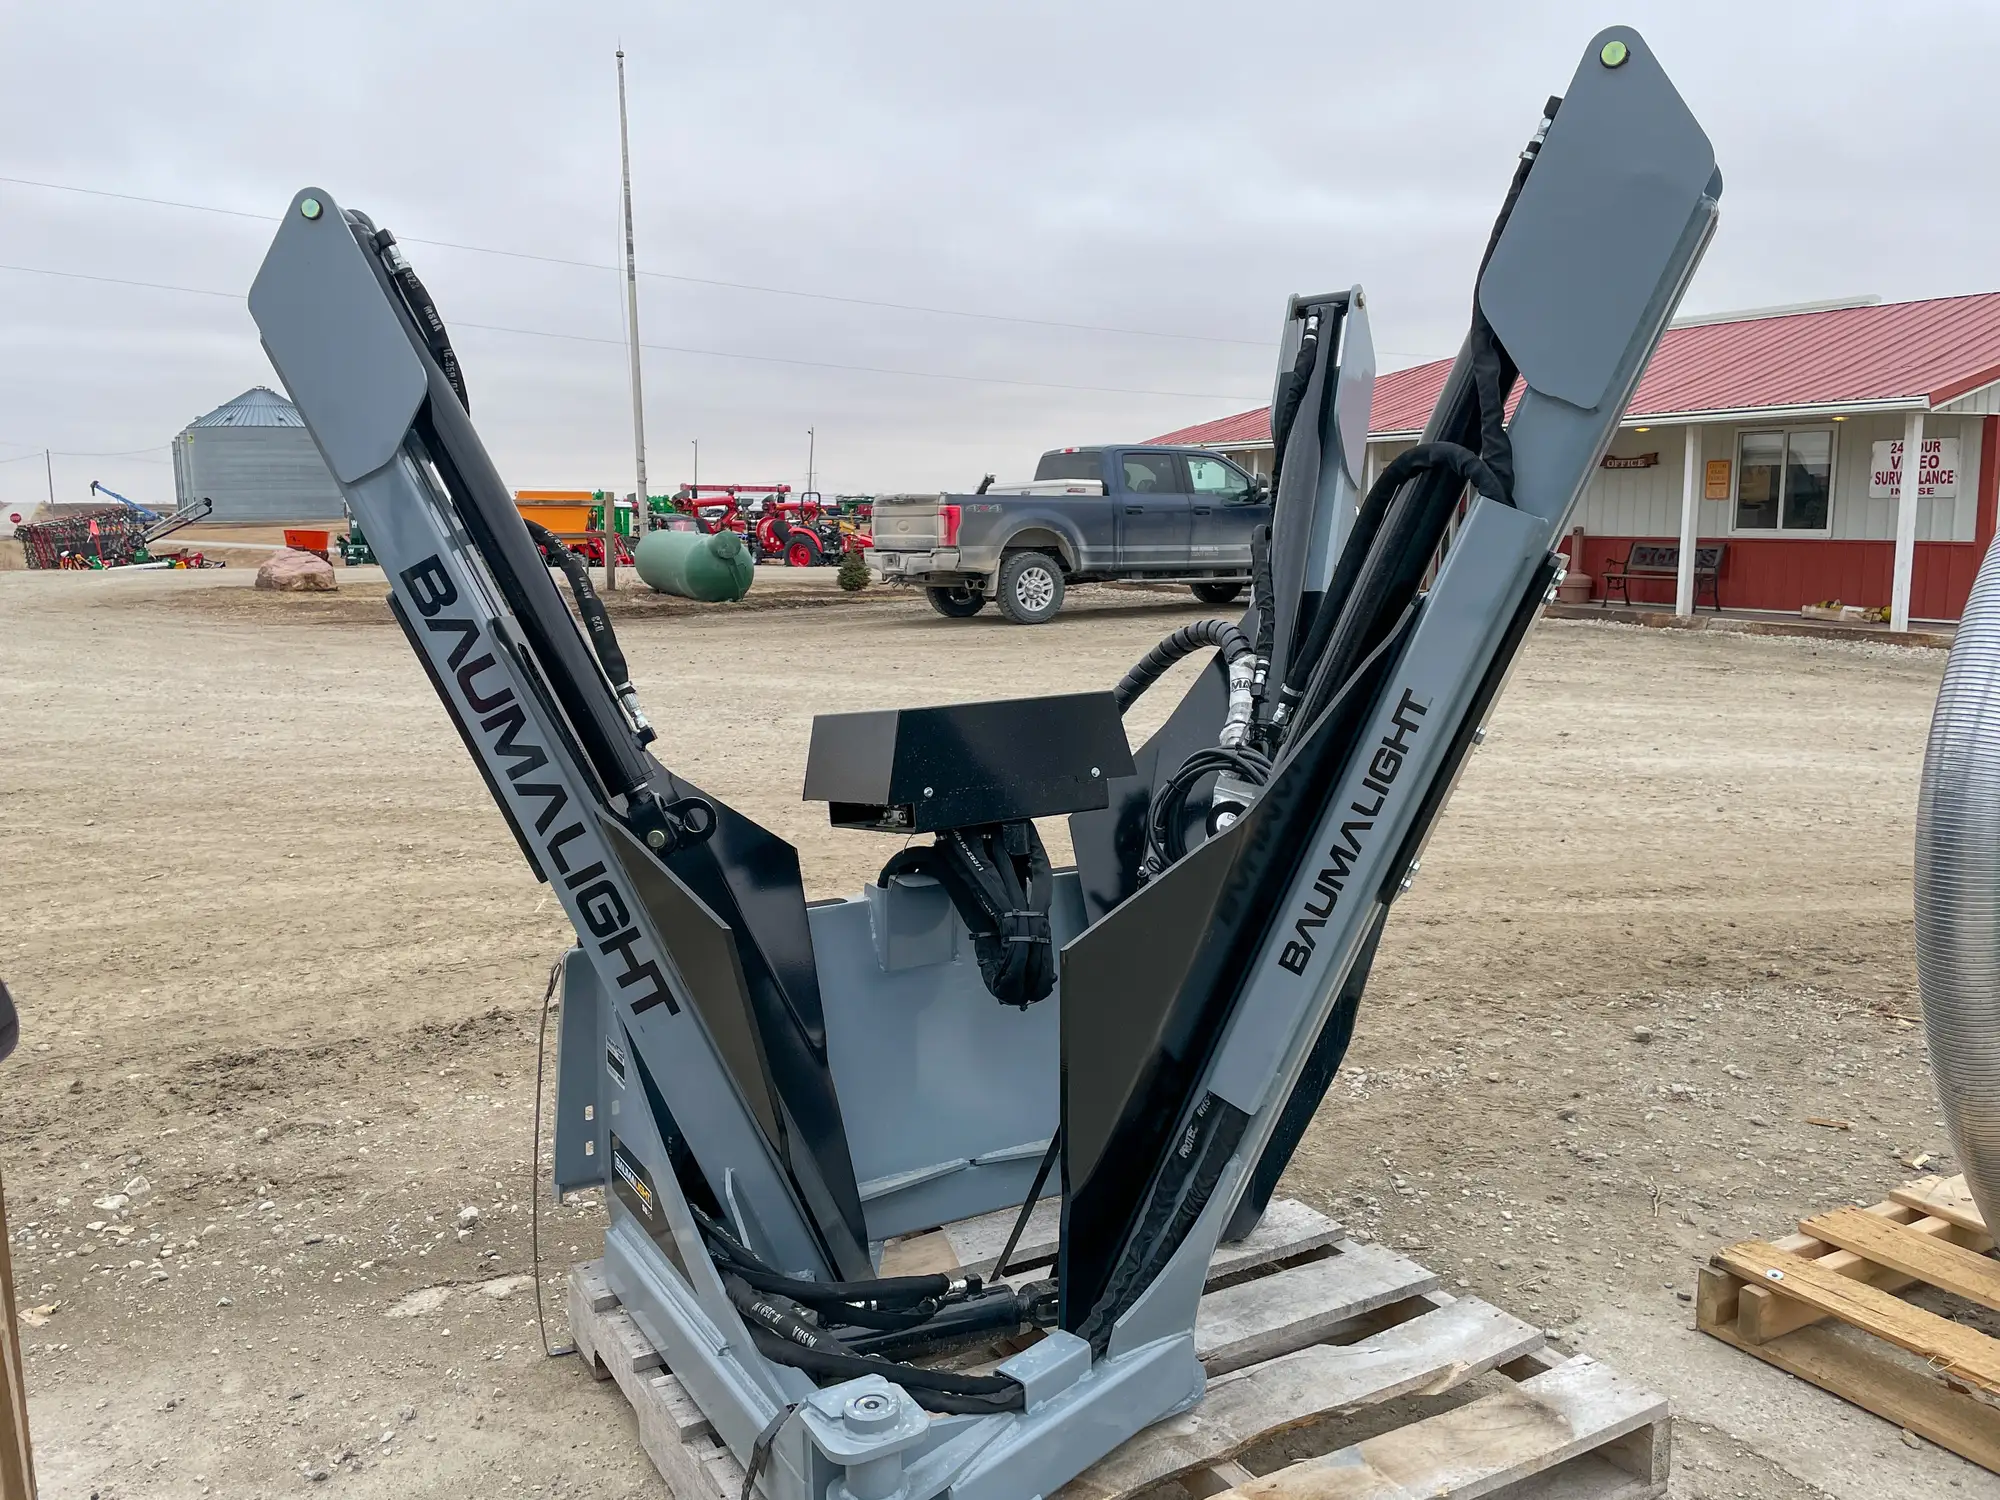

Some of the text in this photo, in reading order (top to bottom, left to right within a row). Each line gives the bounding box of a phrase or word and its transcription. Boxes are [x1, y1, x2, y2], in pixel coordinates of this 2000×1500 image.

[1891, 442, 1903, 454] 24
[1606, 458, 1645, 468] OFFICE
[1891, 454, 1940, 470] VEO
[1875, 470, 1954, 485] SURVLANCE
[1918, 487, 1935, 495] SE
[399, 553, 681, 1017] BAUMALIGHT
[1277, 687, 1429, 977] BAUMALIGHT
[1178, 1125, 1199, 1159] PROTEC
[792, 1325, 818, 1348] MSHA
